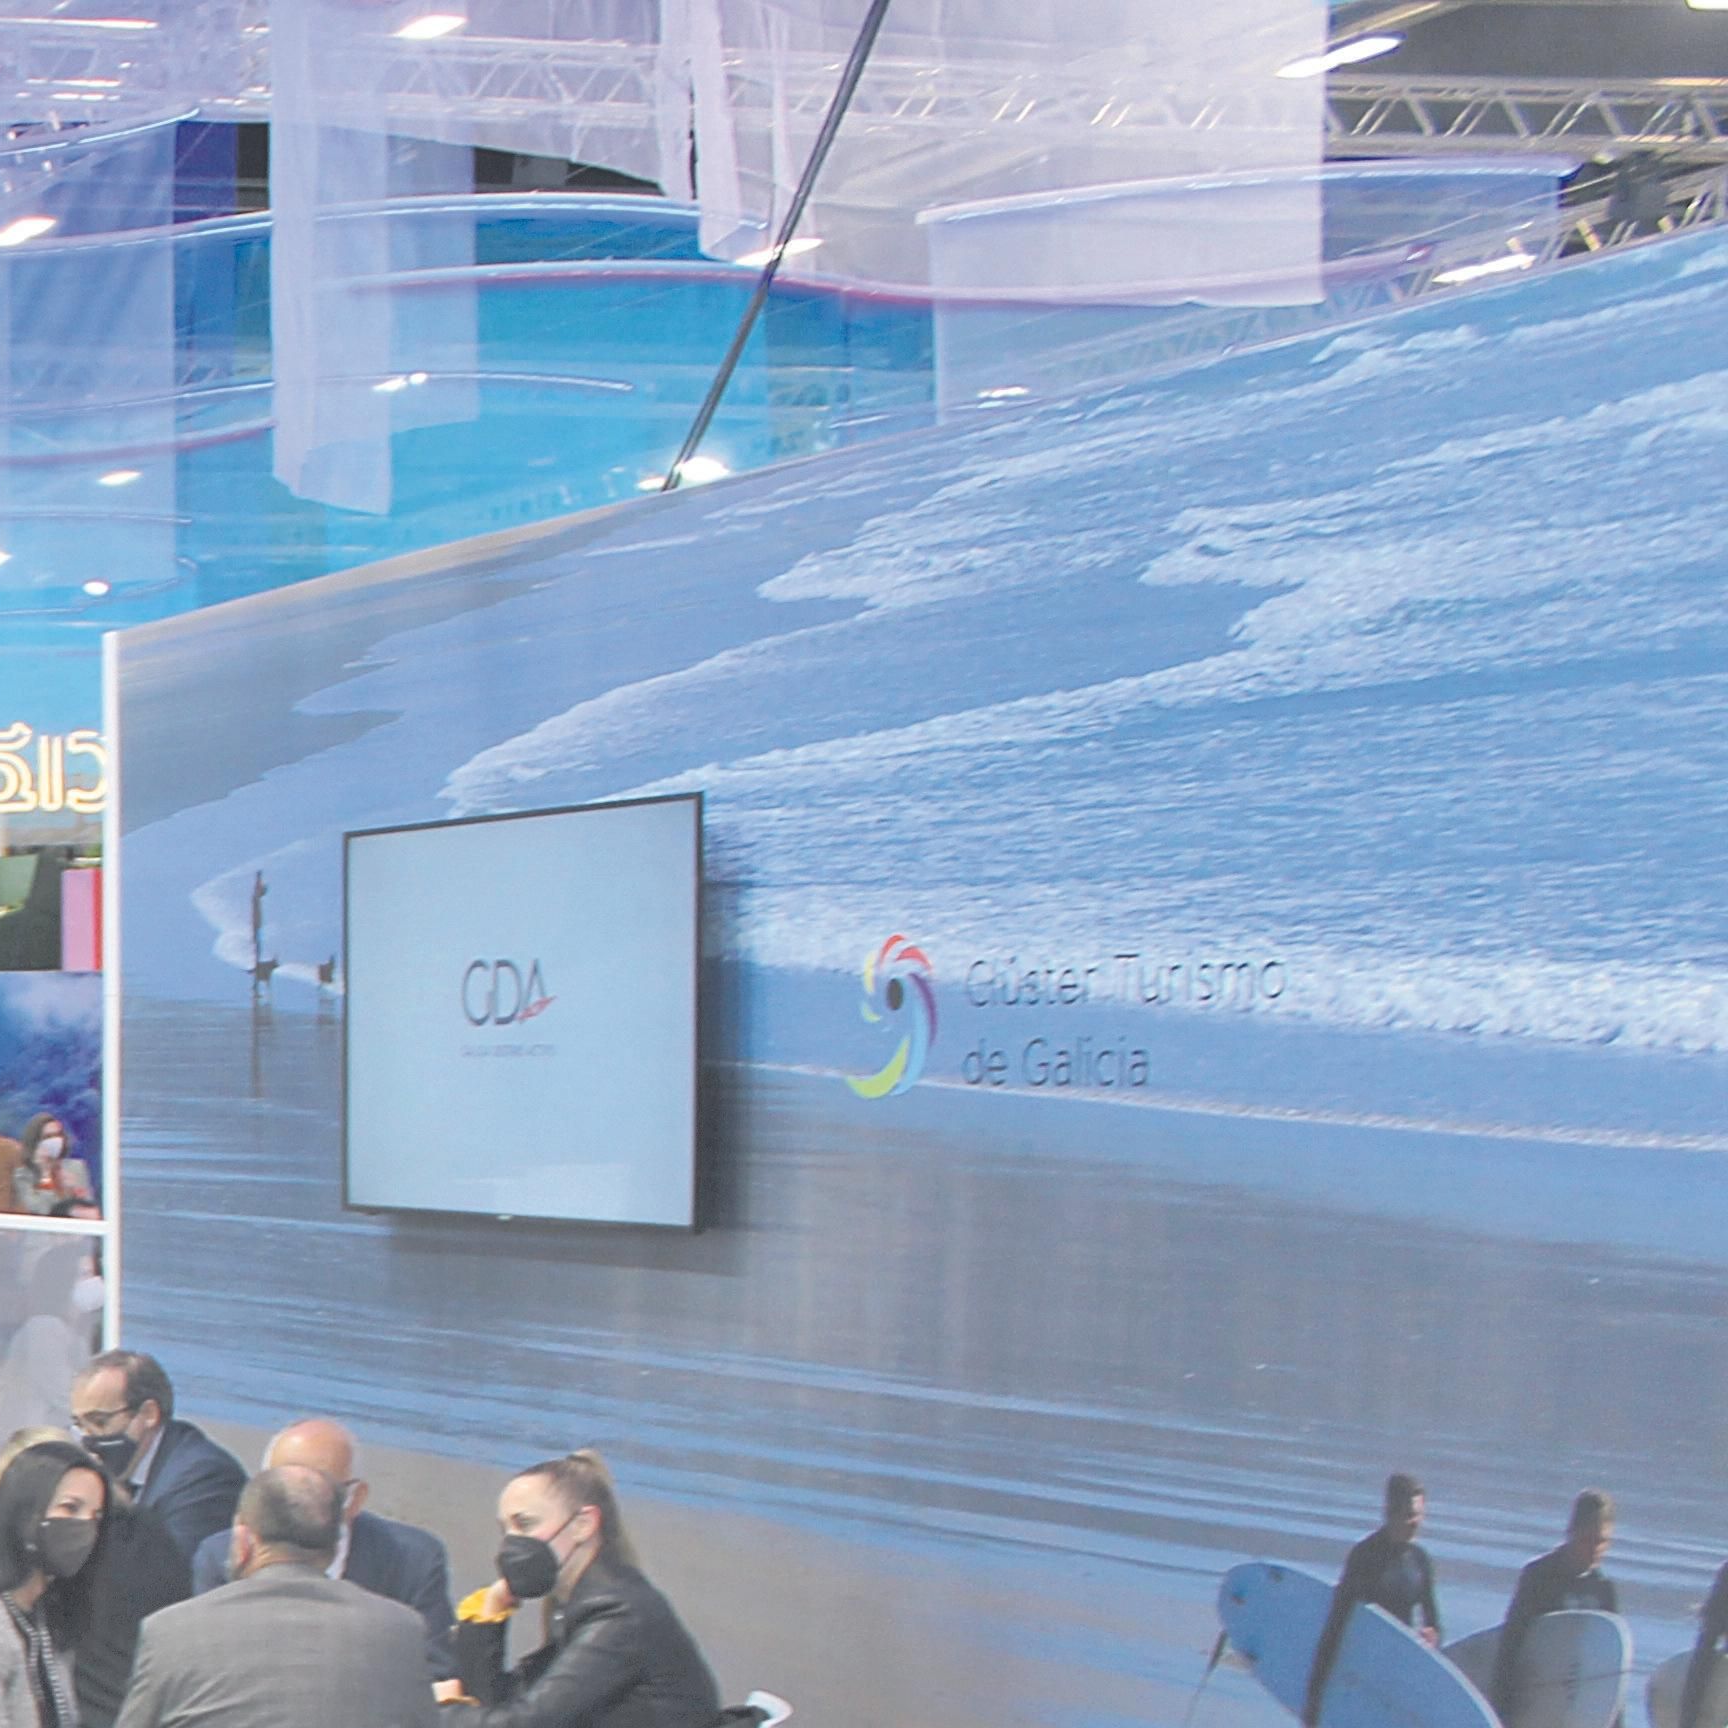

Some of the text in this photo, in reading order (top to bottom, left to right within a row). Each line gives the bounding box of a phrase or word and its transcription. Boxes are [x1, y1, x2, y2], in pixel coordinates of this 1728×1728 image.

[462, 957, 558, 1027] CDA
[1113, 952, 1287, 1004] Turismo
[961, 1035, 1151, 1088] de Galicia
